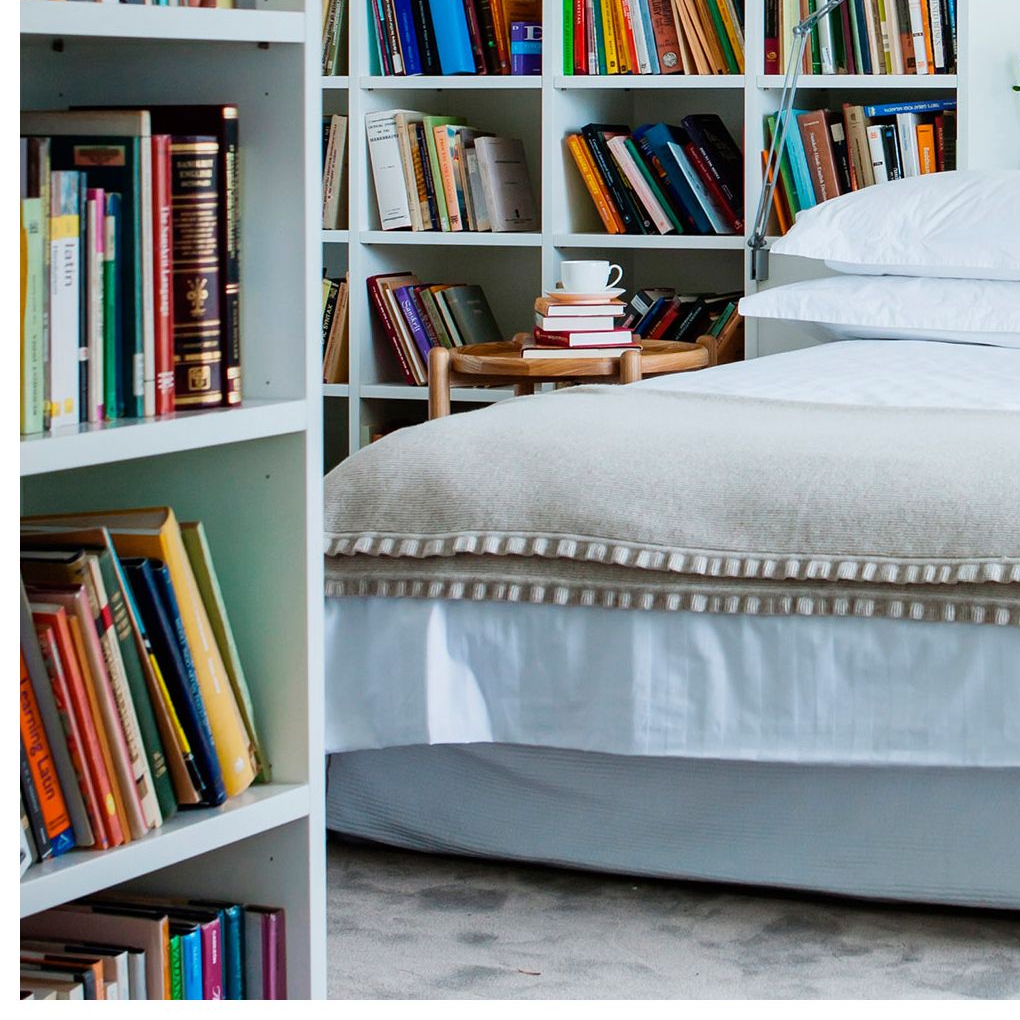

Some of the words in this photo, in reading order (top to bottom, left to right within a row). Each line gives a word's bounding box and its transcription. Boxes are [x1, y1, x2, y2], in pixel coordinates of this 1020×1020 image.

[62, 242, 76, 288] latin
[323, 302, 333, 329] SYNTAX
[398, 297, 426, 334] Sanskrit
[37, 753, 56, 801] Latin
